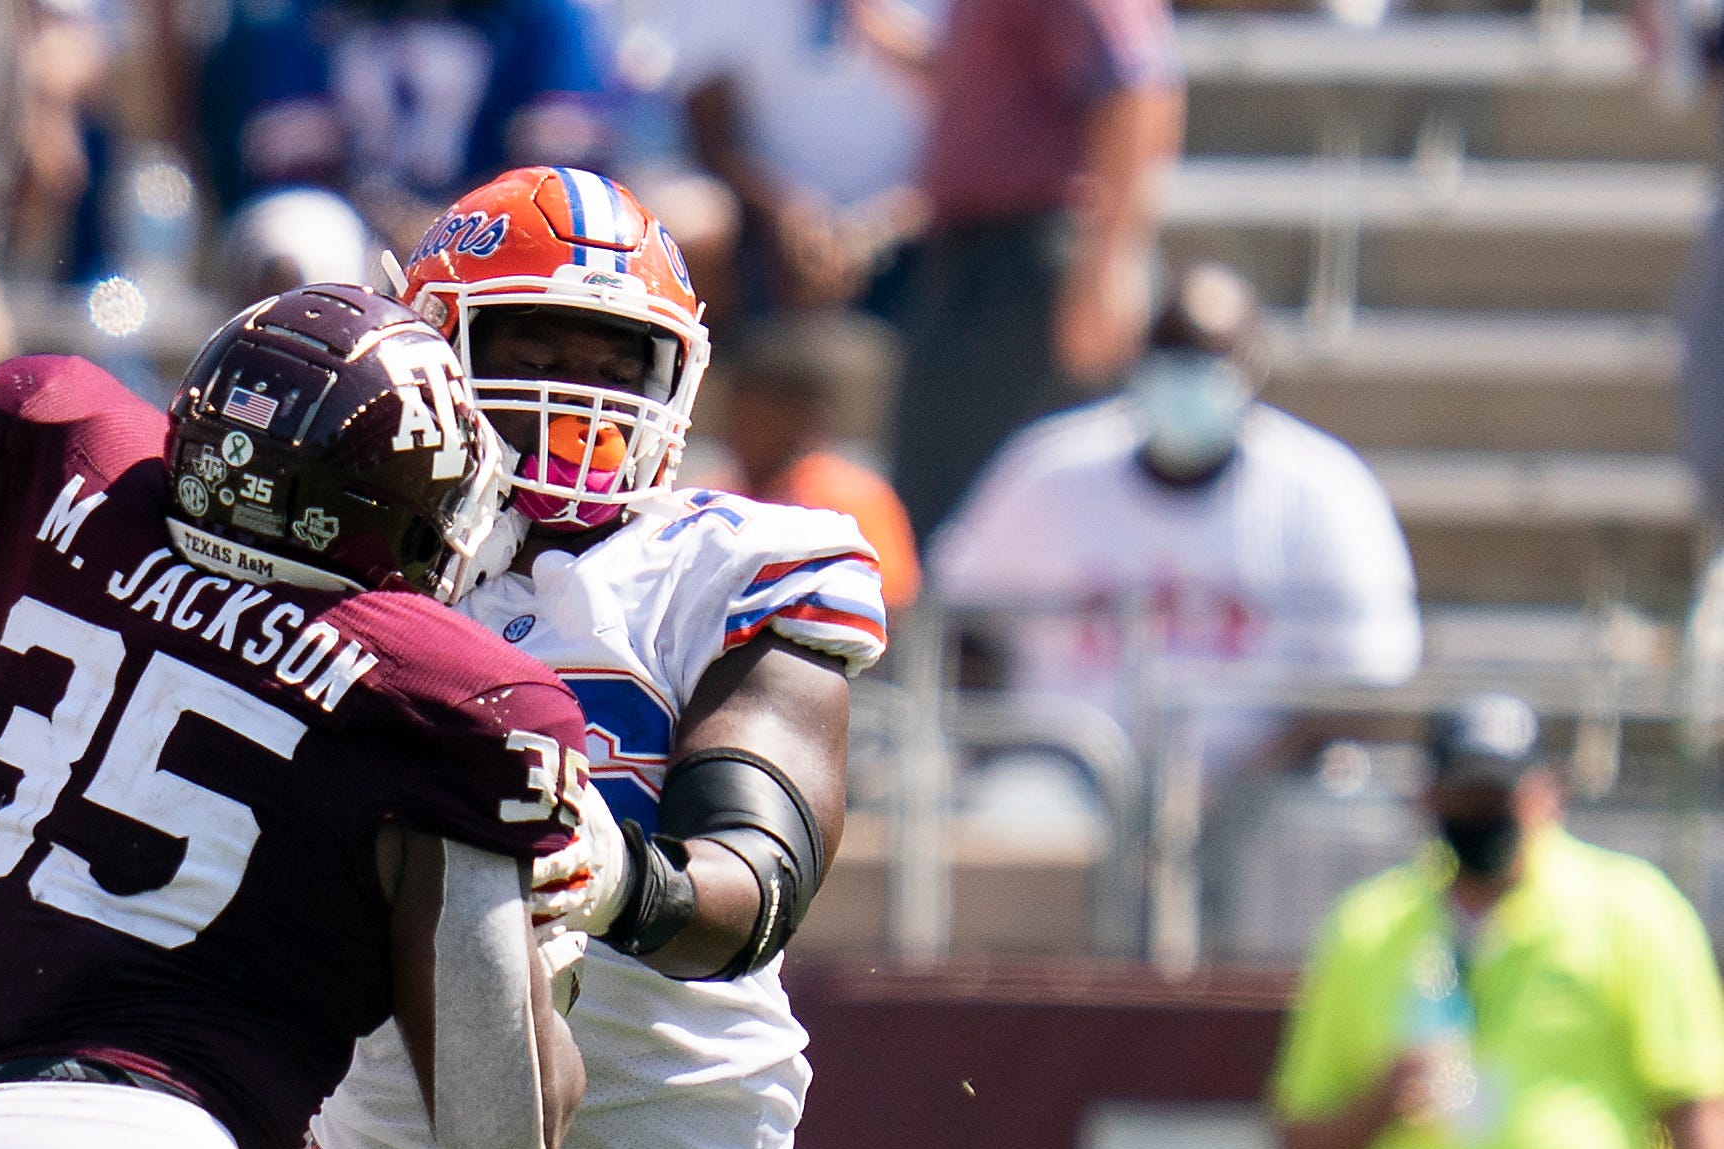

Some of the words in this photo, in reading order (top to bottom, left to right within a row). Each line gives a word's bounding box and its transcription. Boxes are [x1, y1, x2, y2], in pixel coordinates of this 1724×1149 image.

[239, 473, 275, 503] 35
[185, 532, 232, 565] TEXAS
[237, 553, 274, 578] A&M
[36, 474, 108, 570] M.
[107, 547, 379, 712] JACKSON
[499, 729, 590, 826] 35
